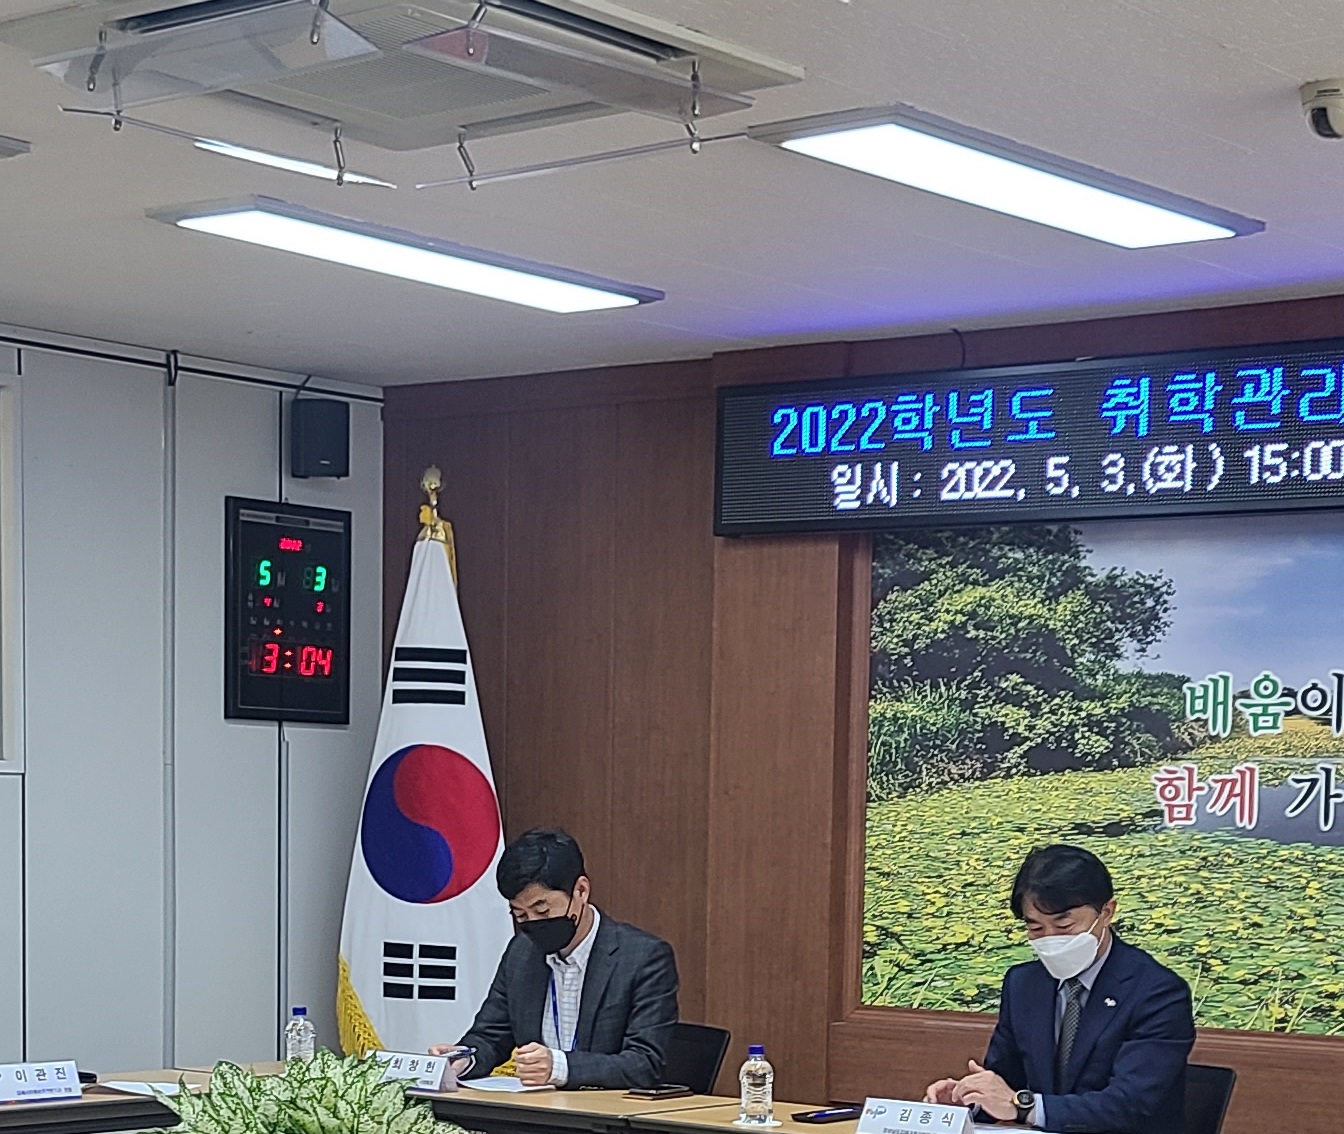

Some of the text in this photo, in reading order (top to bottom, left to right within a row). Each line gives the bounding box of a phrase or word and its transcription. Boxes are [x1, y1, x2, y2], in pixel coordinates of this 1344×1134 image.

[770, 386, 1057, 457] 2022학년도
[831, 460, 899, 510] 일시
[259, 559, 327, 592] 5 3
[261, 642, 333, 676] 3:04
[1153, 764, 1258, 829] 함께
